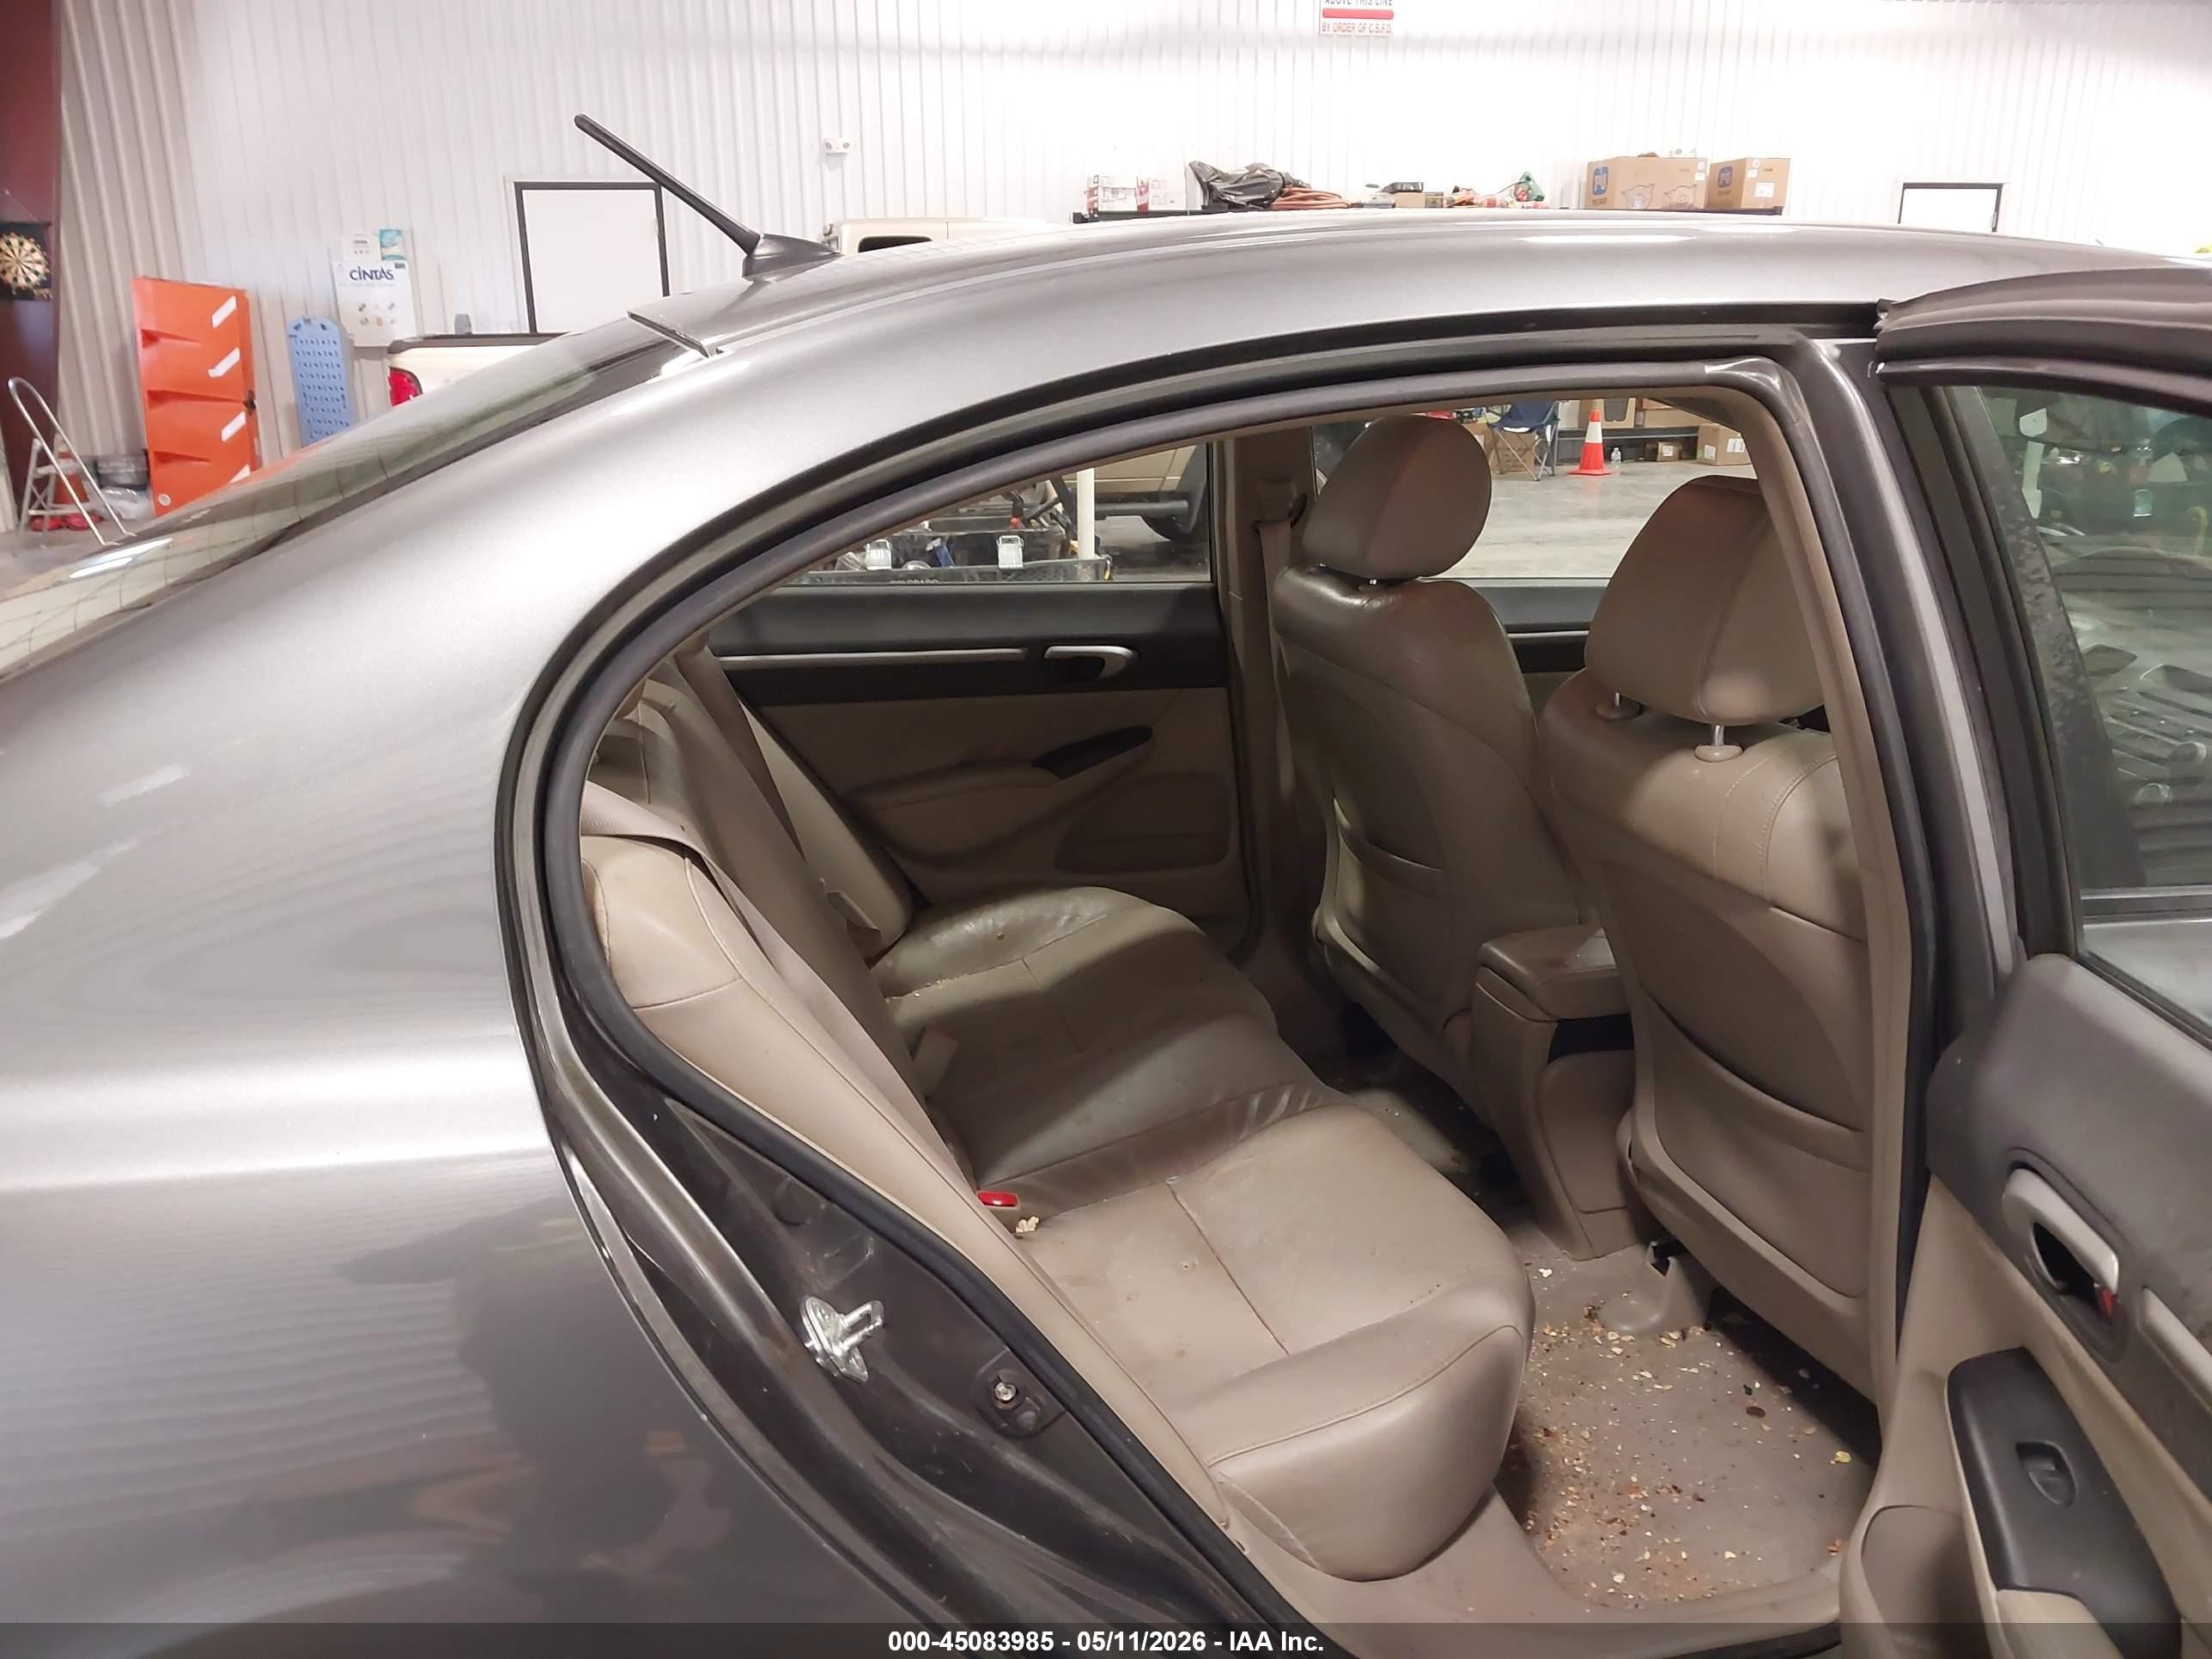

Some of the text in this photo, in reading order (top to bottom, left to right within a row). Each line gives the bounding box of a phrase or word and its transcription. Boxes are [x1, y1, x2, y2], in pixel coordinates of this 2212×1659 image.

[1322, 22, 1330, 32] BY
[1333, 22, 1355, 33] ORDER
[1358, 22, 1367, 33] OF
[349, 266, 394, 281] CINTAS
